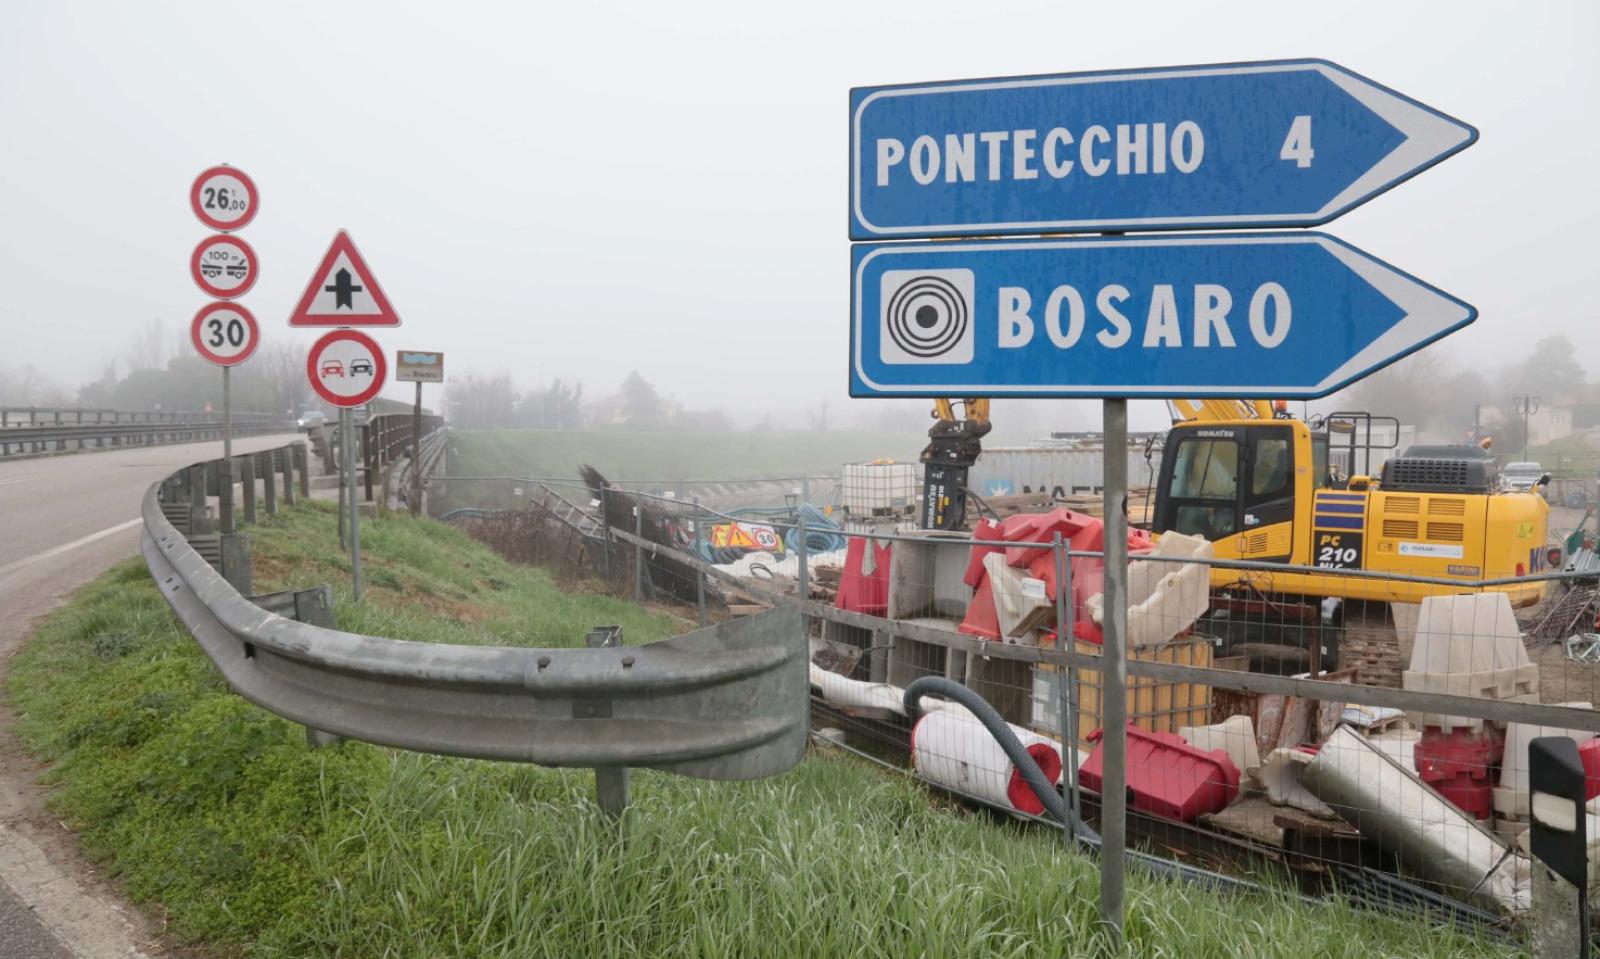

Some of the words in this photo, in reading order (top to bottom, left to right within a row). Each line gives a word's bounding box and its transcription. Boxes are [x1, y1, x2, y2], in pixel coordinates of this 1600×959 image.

[877, 120, 1204, 186] PONTECCHIO
[1280, 115, 1314, 168] 4
[209, 251, 229, 260] 100
[998, 281, 1292, 349] BOSARO
[208, 318, 244, 348] 30
[927, 484, 937, 529] KOMATSU
[759, 534, 774, 544] 30
[1320, 535, 1341, 546] PC
[1319, 547, 1357, 562] 210
